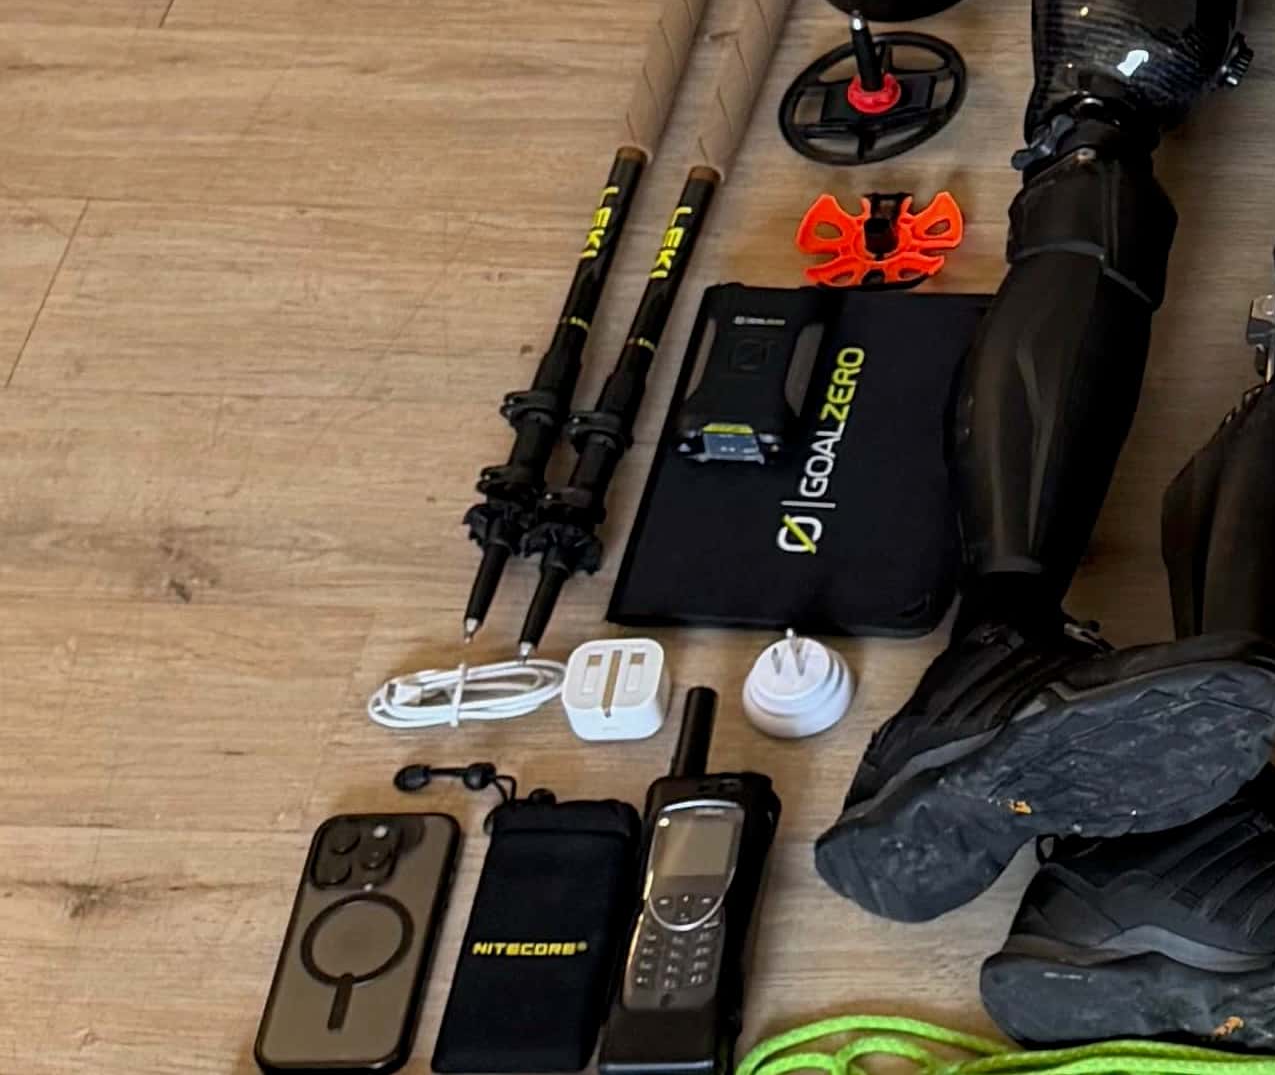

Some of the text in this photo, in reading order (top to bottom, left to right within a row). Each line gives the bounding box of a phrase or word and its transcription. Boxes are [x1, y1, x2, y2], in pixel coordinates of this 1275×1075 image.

[580, 186, 619, 258] LEKI
[650, 206, 692, 279] LEKI
[472, 941, 578, 956] NITECORE
